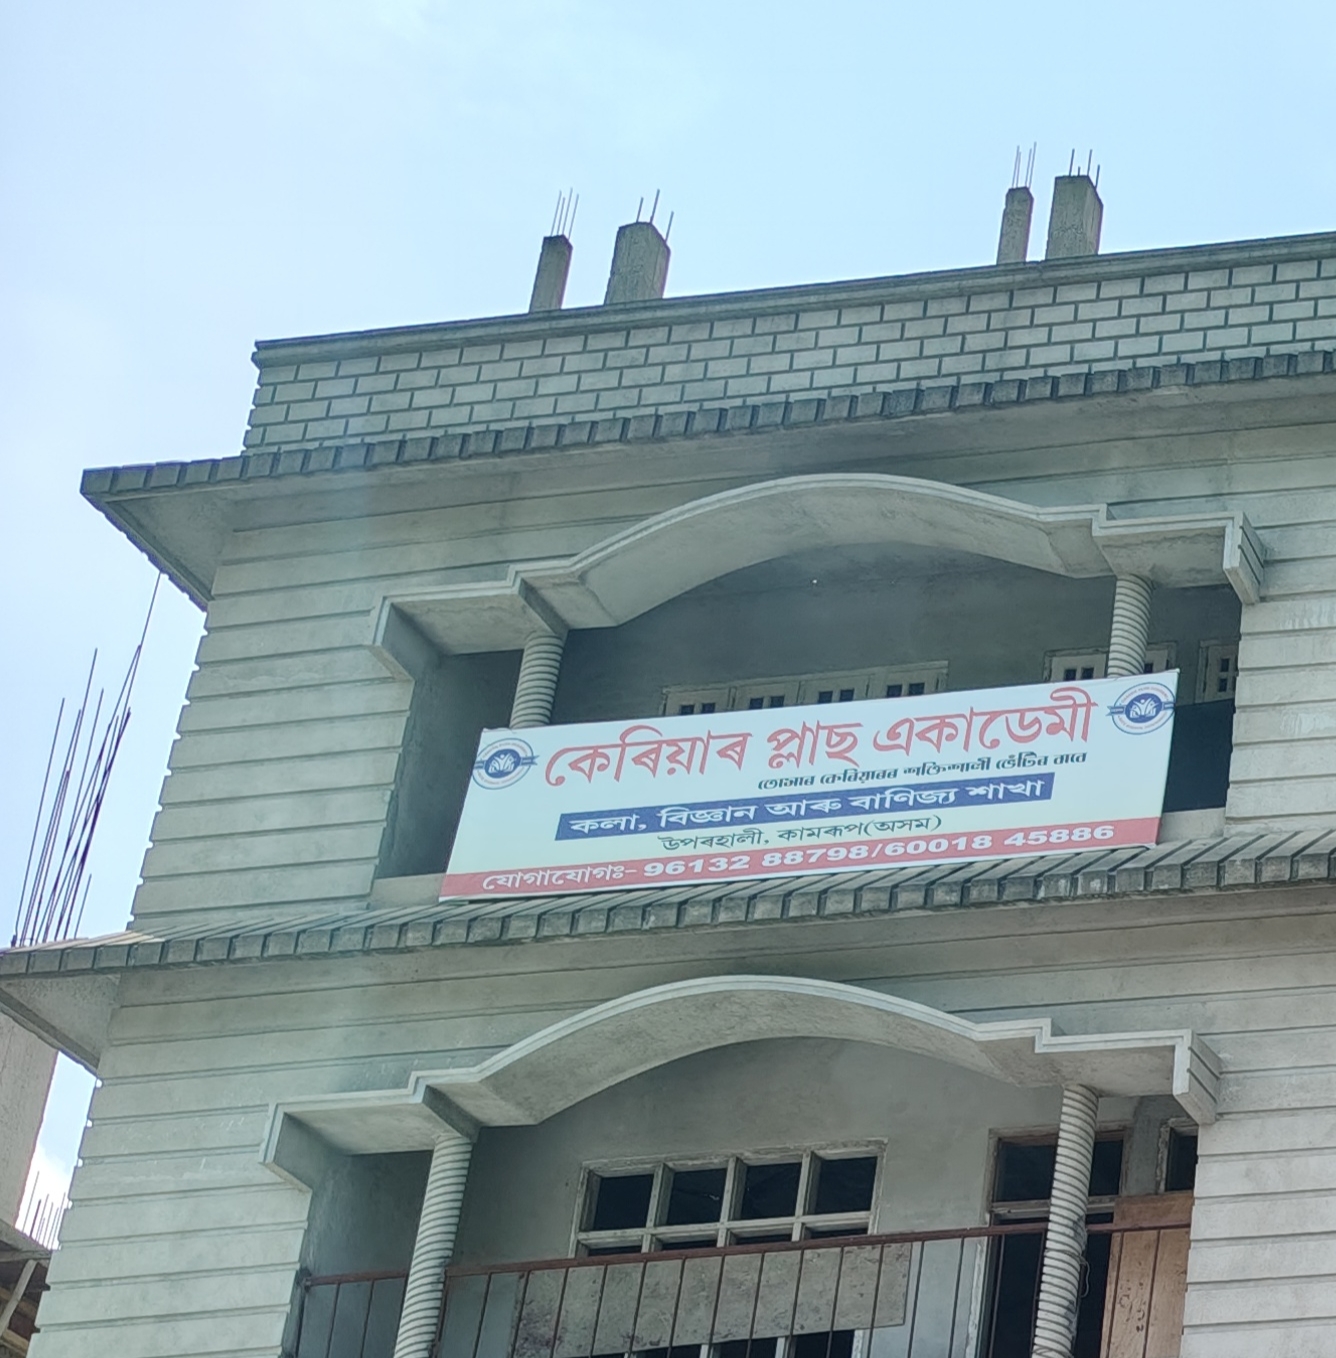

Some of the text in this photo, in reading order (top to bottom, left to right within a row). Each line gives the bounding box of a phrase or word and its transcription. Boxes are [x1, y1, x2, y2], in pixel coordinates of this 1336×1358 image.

[545, 724, 754, 787] কেৰিয়াৰ
[766, 719, 864, 769] প্লাছ
[872, 686, 1099, 757] একাডেমী
[569, 780, 1045, 835] কলা, বিজ্ঞান আৰু বাণিজ্য শাখা
[643, 856, 750, 877] 96132
[761, 835, 993, 867] 88798/60018
[1004, 825, 1115, 847] 45886
